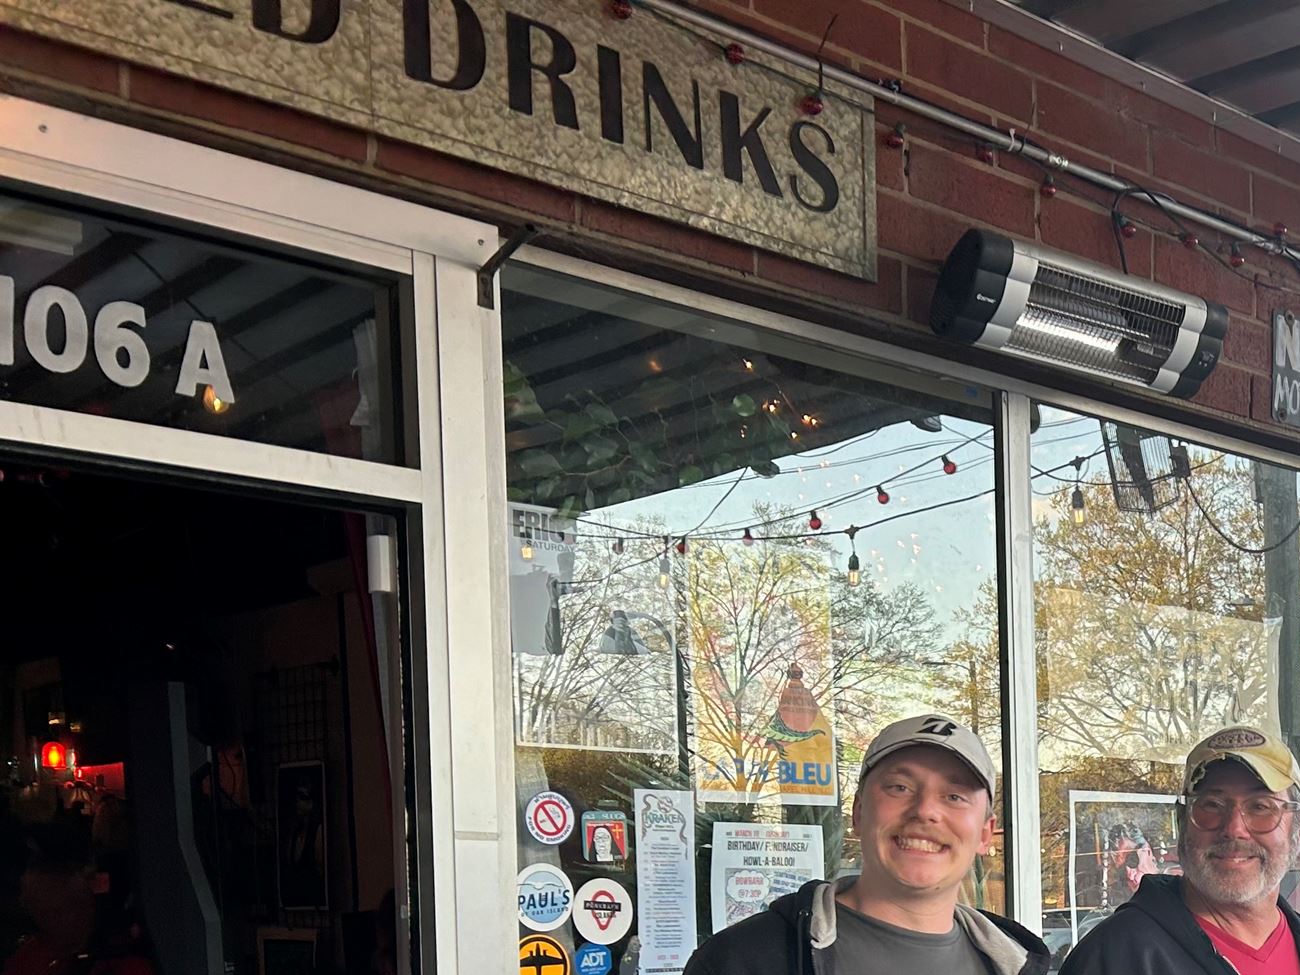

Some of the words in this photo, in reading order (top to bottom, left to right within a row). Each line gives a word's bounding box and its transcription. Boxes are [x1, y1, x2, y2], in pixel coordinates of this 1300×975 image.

[402, 0, 842, 214] DRINKS
[174, 319, 236, 404] A
[727, 841, 764, 851] BIRTHDAY/
[518, 889, 570, 911] PAUL'S
[581, 952, 607, 968] ADT
